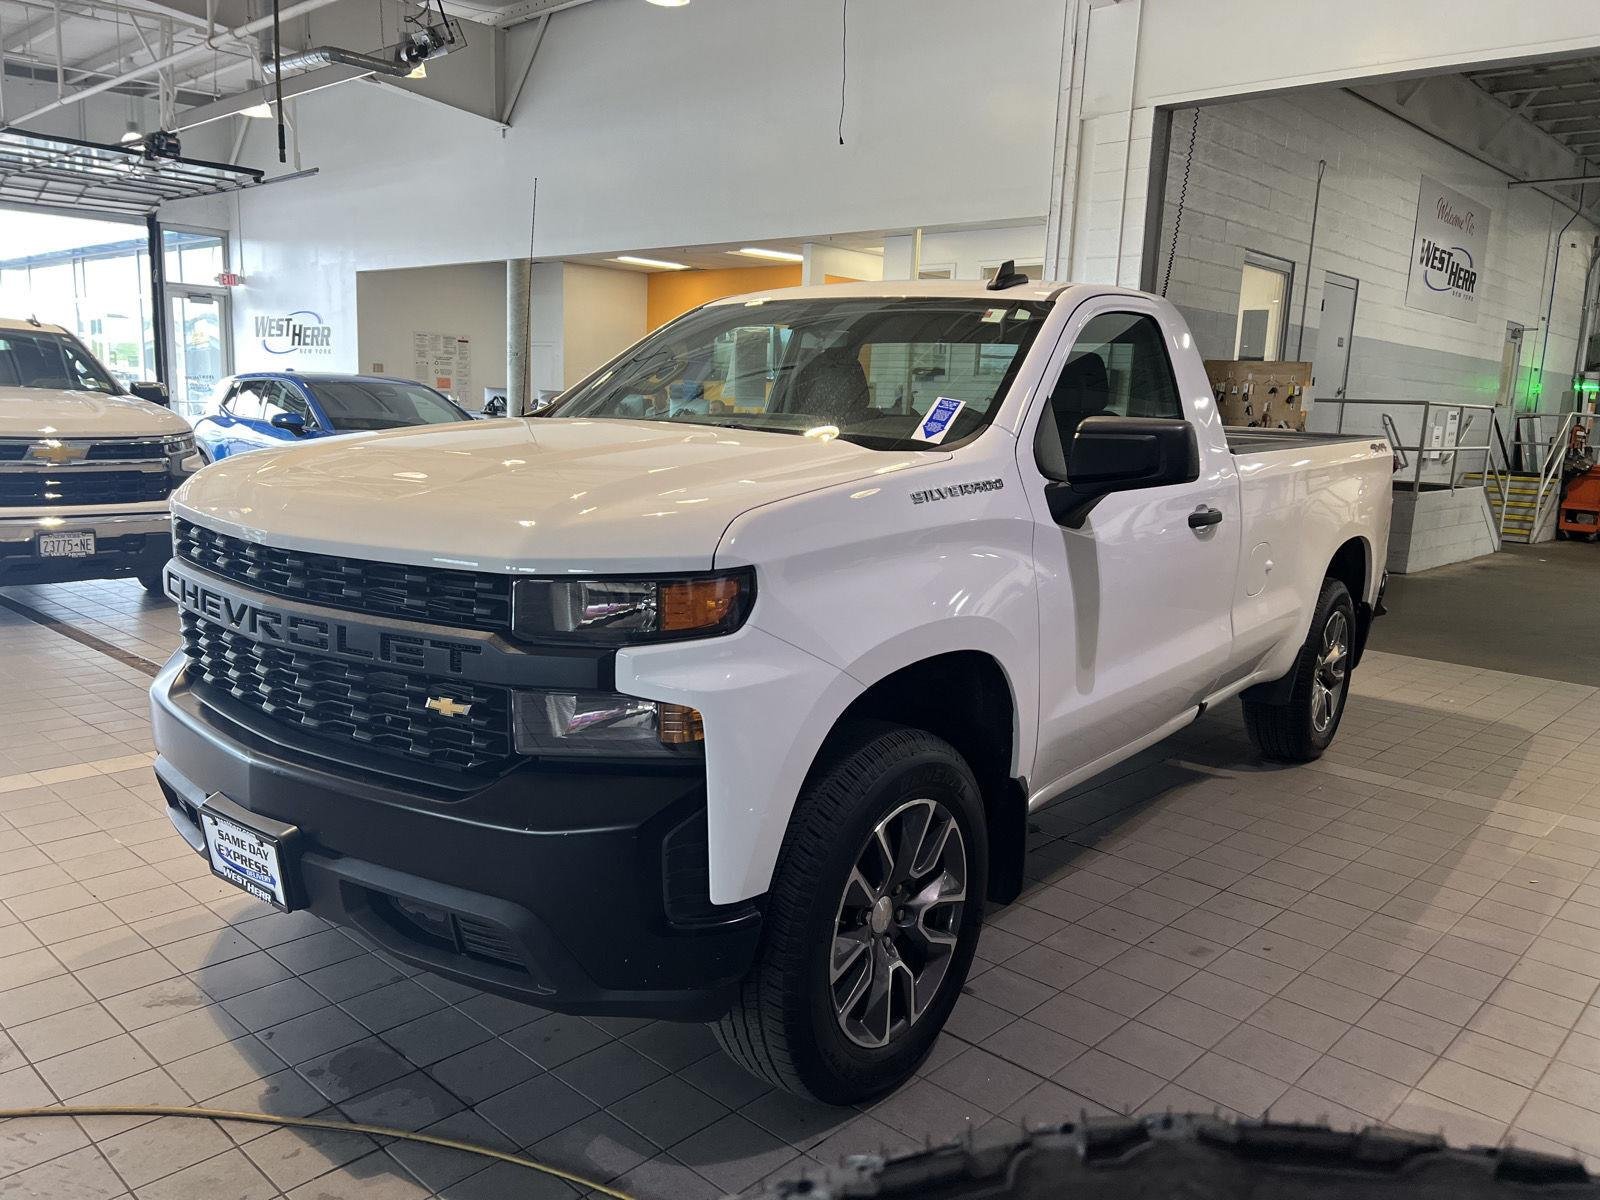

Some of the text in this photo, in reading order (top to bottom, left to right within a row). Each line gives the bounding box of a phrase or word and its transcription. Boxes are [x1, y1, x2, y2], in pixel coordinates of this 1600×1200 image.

[1437, 197, 1464, 230] Welcome
[1419, 238, 1454, 274] WEST
[1447, 261, 1477, 293] HERR
[254, 316, 293, 337] WEST
[291, 324, 331, 346] HERR
[910, 478, 1004, 505] SILVERADO
[167, 570, 483, 674] CHEVROLET
[217, 829, 269, 860] SAME DAY
[217, 843, 269, 876] EXPRESS
[222, 865, 248, 886] WEST
[246, 881, 272, 903] HERR
